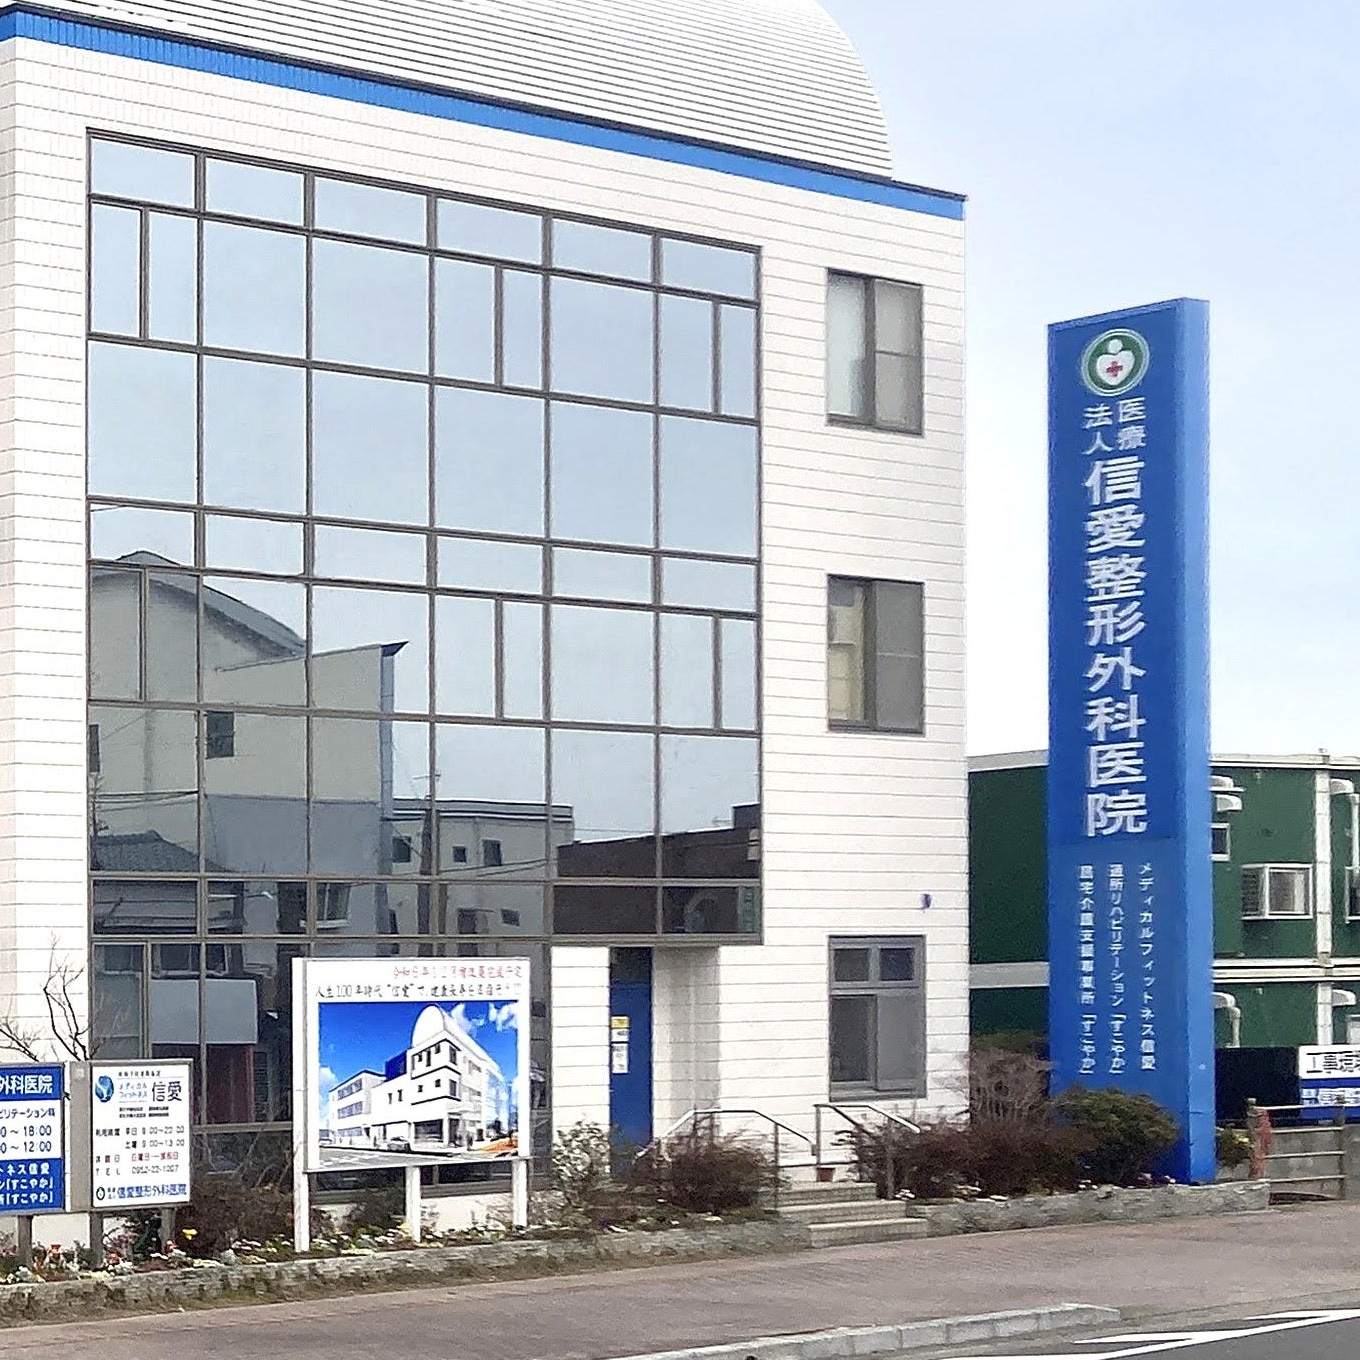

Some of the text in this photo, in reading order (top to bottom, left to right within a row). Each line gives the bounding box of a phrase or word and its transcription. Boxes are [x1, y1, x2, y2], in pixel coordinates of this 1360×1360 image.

[1082, 404, 1114, 455] 法人
[1115, 397, 1148, 449] 医療
[1083, 455, 1149, 838] 信愛整形外科医院
[151, 1080, 183, 1102] 信愛
